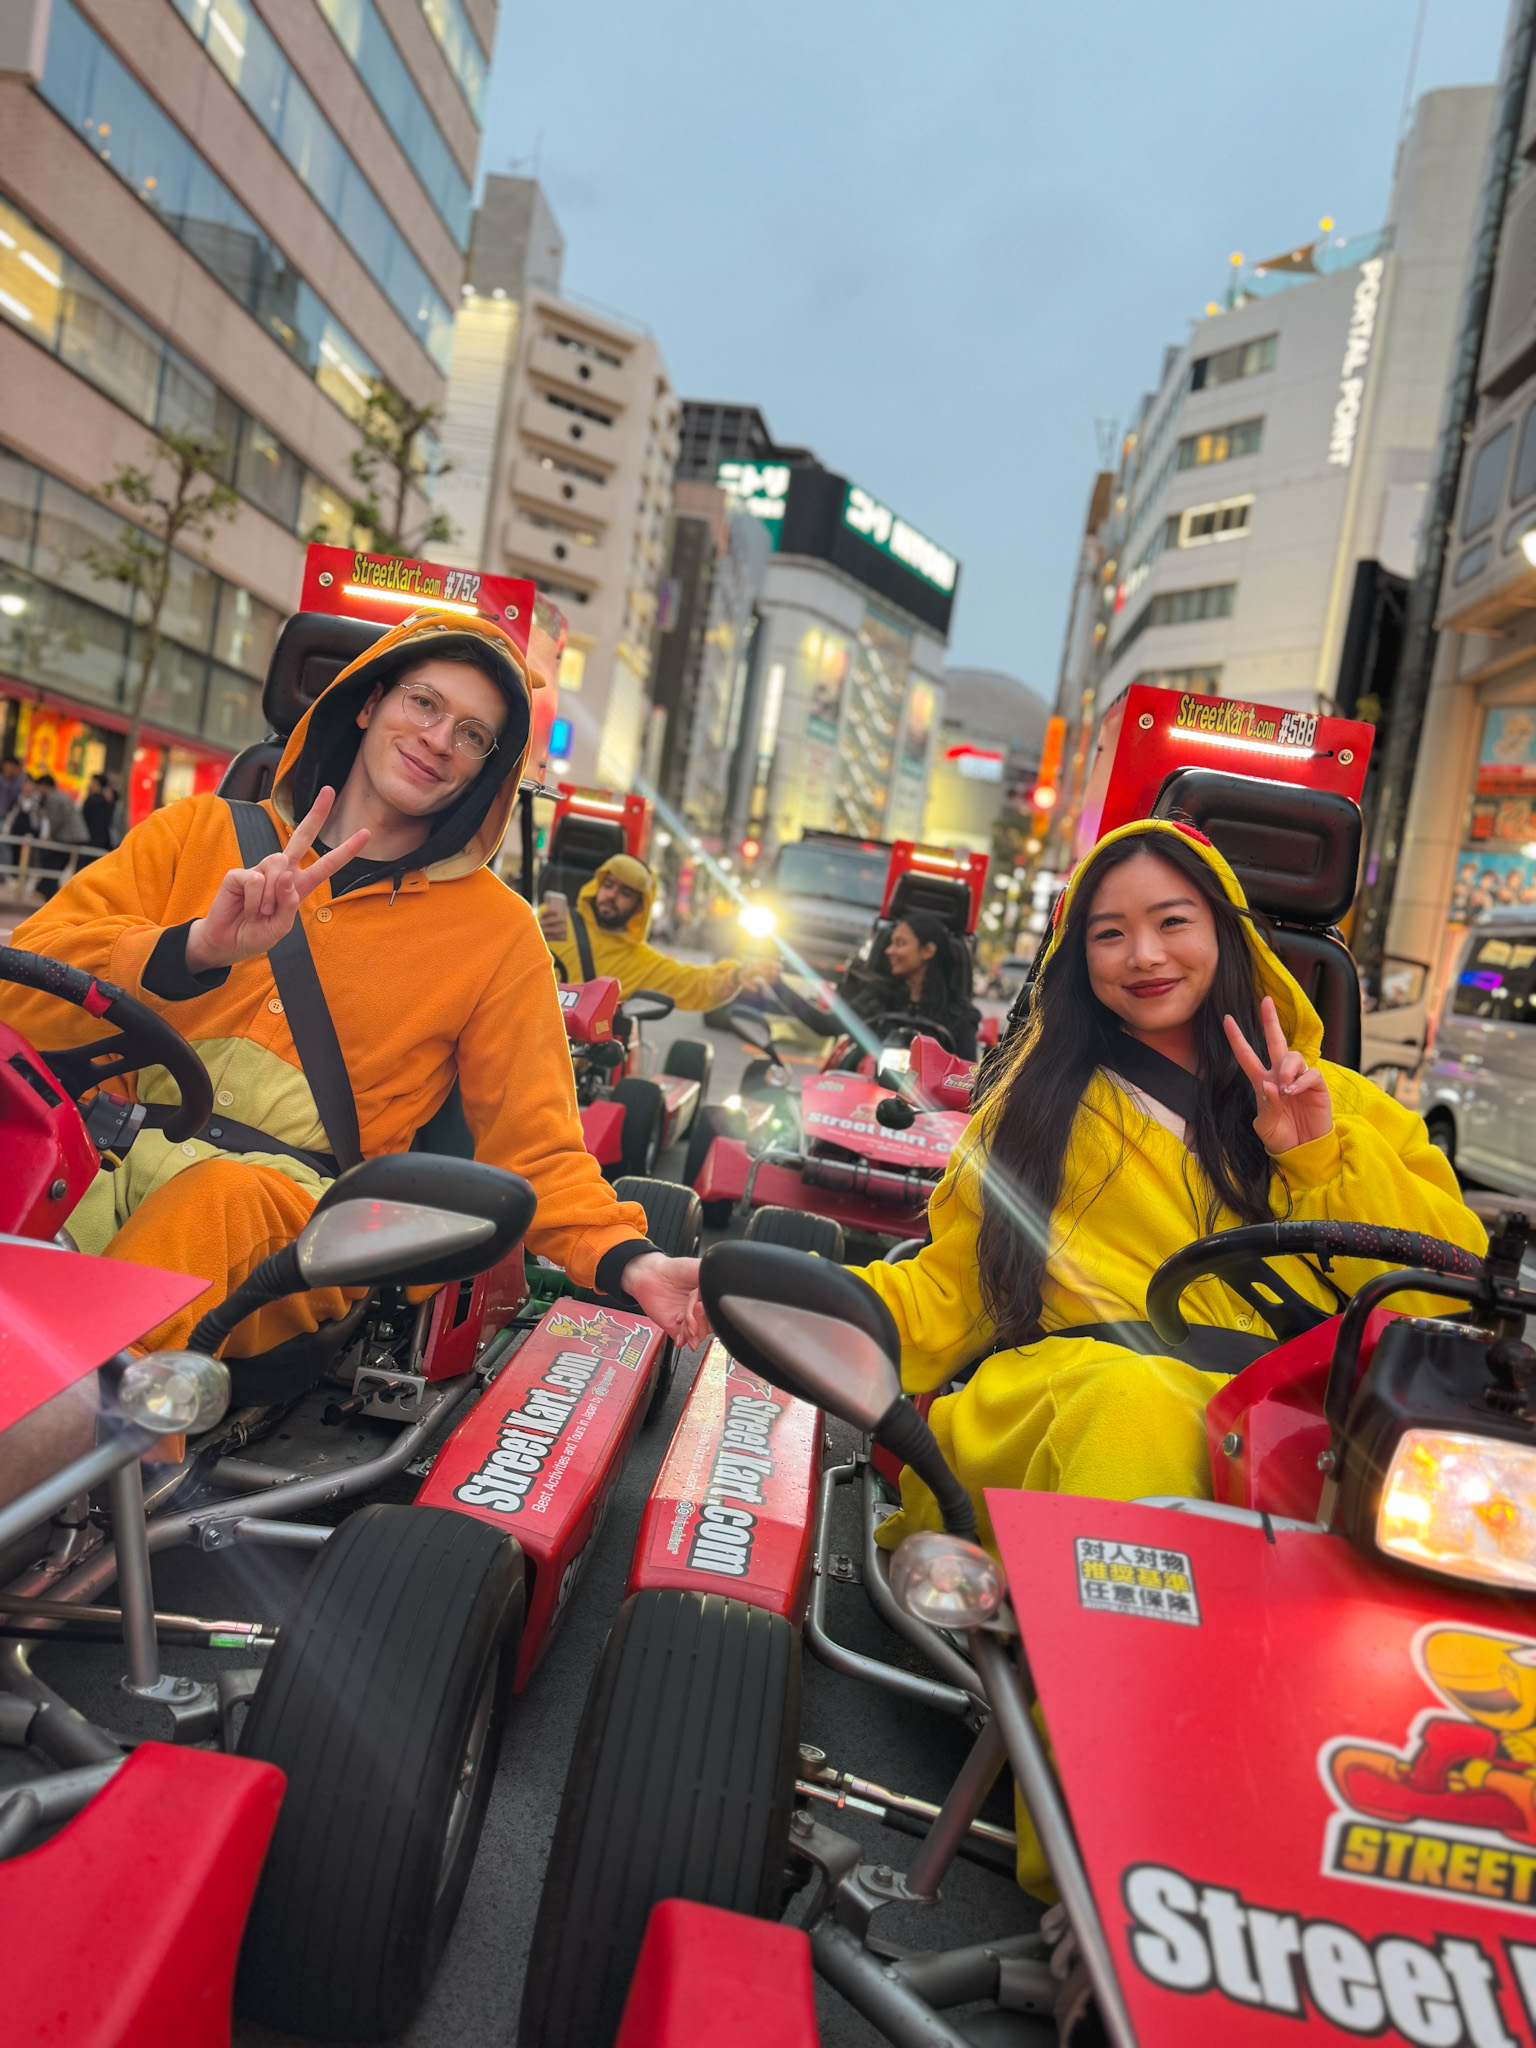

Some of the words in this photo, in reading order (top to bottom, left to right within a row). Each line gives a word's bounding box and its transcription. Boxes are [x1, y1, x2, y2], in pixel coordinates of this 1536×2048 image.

[1341, 256, 1385, 379] PORTAL
[1327, 376, 1364, 467] POINT
[352, 552, 441, 596] StreetKart.com
[443, 570, 481, 603] #752
[1176, 694, 1276, 740] StreetKart.com
[1277, 713, 1317, 747] #588
[581, 1403, 599, 1420] Japan
[592, 1395, 603, 1404] by
[567, 1426, 586, 1443] Tours
[577, 1419, 590, 1428] in
[563, 1442, 578, 1456] and
[543, 1455, 571, 1491] Activities
[532, 1491, 553, 1513] Best
[1081, 1540, 1185, 1573] 対人対物
[1084, 1580, 1192, 1615] 任意保険
[1342, 1825, 1536, 1902] STREET
[1122, 1864, 1521, 2048] Street
